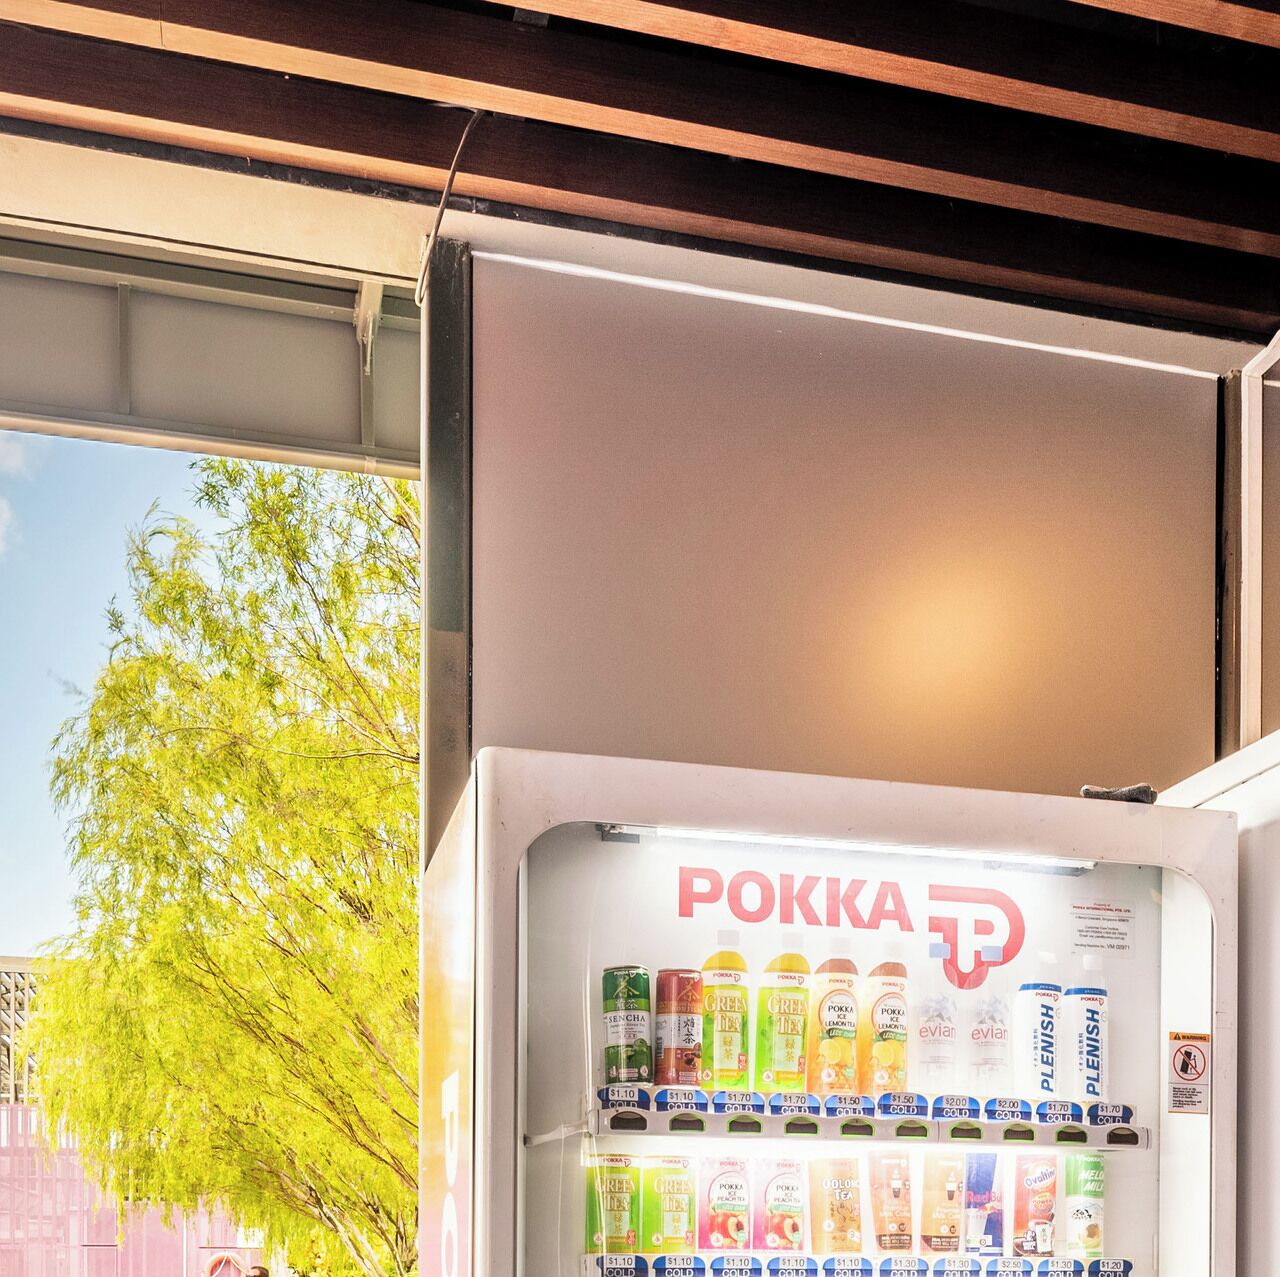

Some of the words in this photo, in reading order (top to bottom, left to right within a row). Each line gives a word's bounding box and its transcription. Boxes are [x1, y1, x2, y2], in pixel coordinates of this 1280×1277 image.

[678, 866, 915, 933] POKKA
[828, 1005, 854, 1013] POKKA
[881, 1008, 906, 1016] POKKA
[609, 1014, 646, 1023] SENCHA
[1041, 1003, 1055, 1093] PLENISH
[1086, 1008, 1100, 1097] PLENISH
[610, 1089, 635, 1099] $1.10
[670, 1092, 694, 1101] $1.10
[728, 1094, 751, 1102] $1.70
[784, 1095, 806, 1104] $1.70
[838, 1096, 860, 1105] $1.50
[892, 1095, 914, 1104] $1.50
[945, 1097, 967, 1107] $2.00
[609, 1101, 638, 1109] COLD
[667, 1103, 697, 1111] COLD
[725, 1104, 753, 1112] COLD
[998, 1100, 1019, 1109] $2.00
[1048, 1103, 1069, 1112] $1.70
[1100, 1104, 1121, 1114] $1.70
[836, 1108, 863, 1116] COLD
[890, 1105, 918, 1114] COLD
[943, 1108, 970, 1118] COLD
[995, 1111, 1022, 1120] COLD
[1047, 1114, 1073, 1123] COLD
[1097, 1115, 1123, 1124] COLD
[719, 1183, 743, 1191] POKKA
[834, 1189, 854, 1201] TEA
[608, 1256, 633, 1267] $1.10
[668, 1256, 692, 1267] $1.10
[726, 1257, 750, 1267] $1.10
[782, 1257, 805, 1267] $1.10
[837, 1257, 860, 1268] $1.10
[893, 1259, 917, 1269] $1.30
[947, 1259, 970, 1269] $1.30
[1001, 1260, 1022, 1270] $2.50
[1050, 1260, 1072, 1270] $1.30
[1101, 1261, 1122, 1271] $1.20
[607, 1268, 636, 1277] COLD
[665, 1269, 694, 1277] COLD
[722, 1269, 751, 1277] COLD
[778, 1269, 807, 1277] COLD
[834, 1269, 862, 1277] COLD
